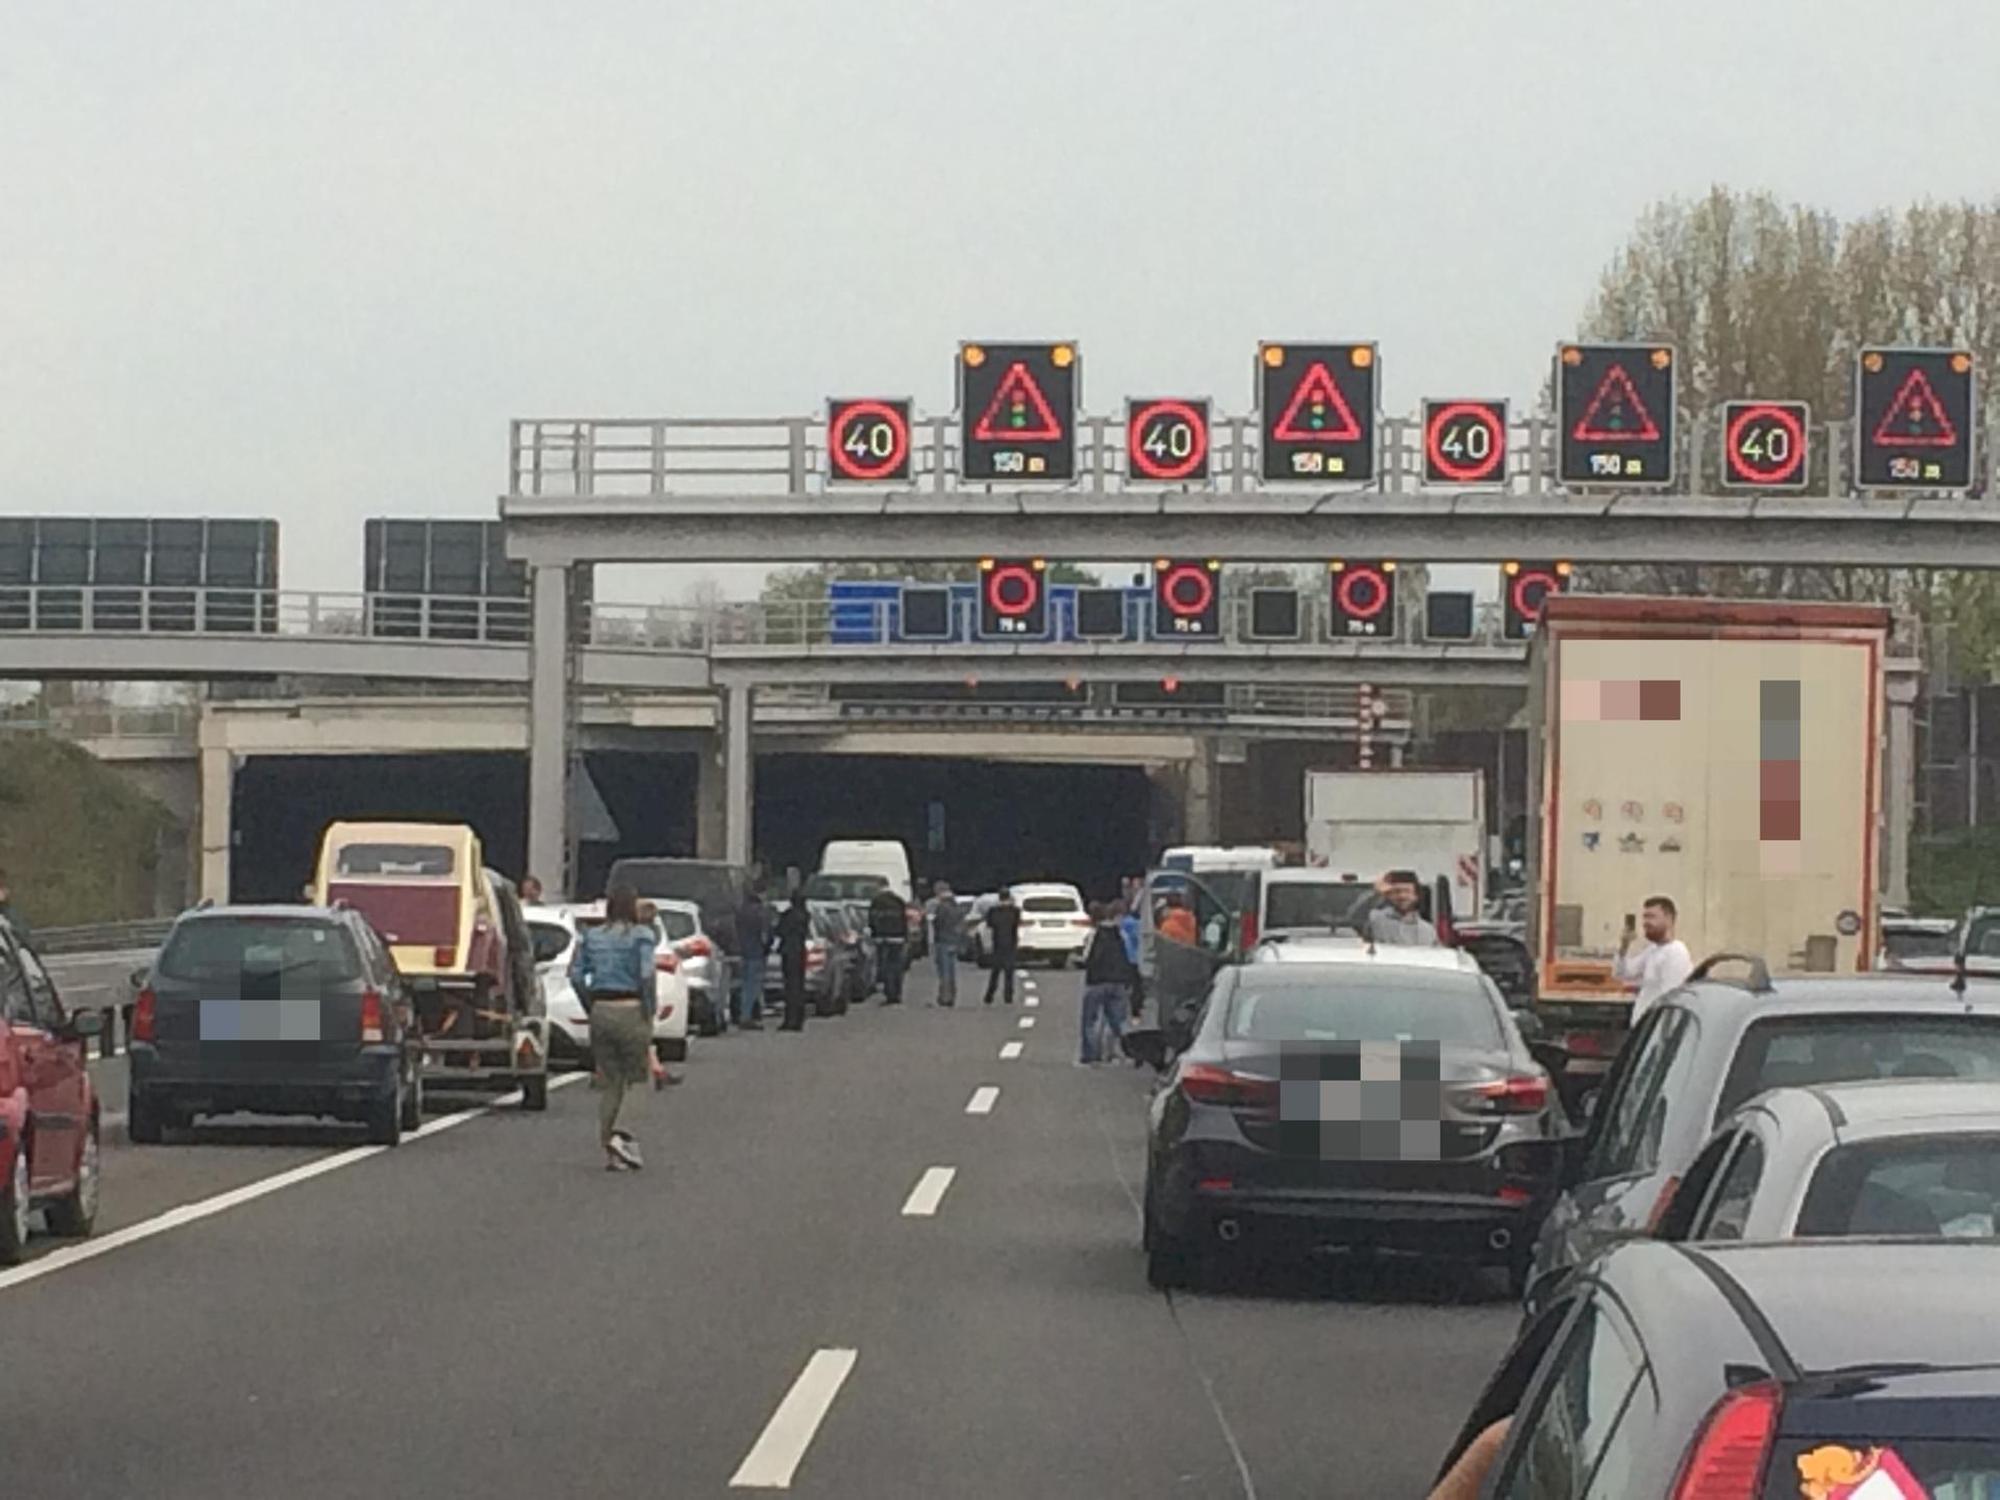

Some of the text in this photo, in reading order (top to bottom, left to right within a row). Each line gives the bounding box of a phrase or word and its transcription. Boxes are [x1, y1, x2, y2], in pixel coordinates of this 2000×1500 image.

[844, 423, 893, 457] 40
[1142, 423, 1192, 457] 40
[1440, 425, 1490, 459] 40
[1739, 427, 1789, 463] 40
[992, 452, 1024, 472] 150
[1291, 452, 1323, 473] 150
[1589, 454, 1621, 475] 150
